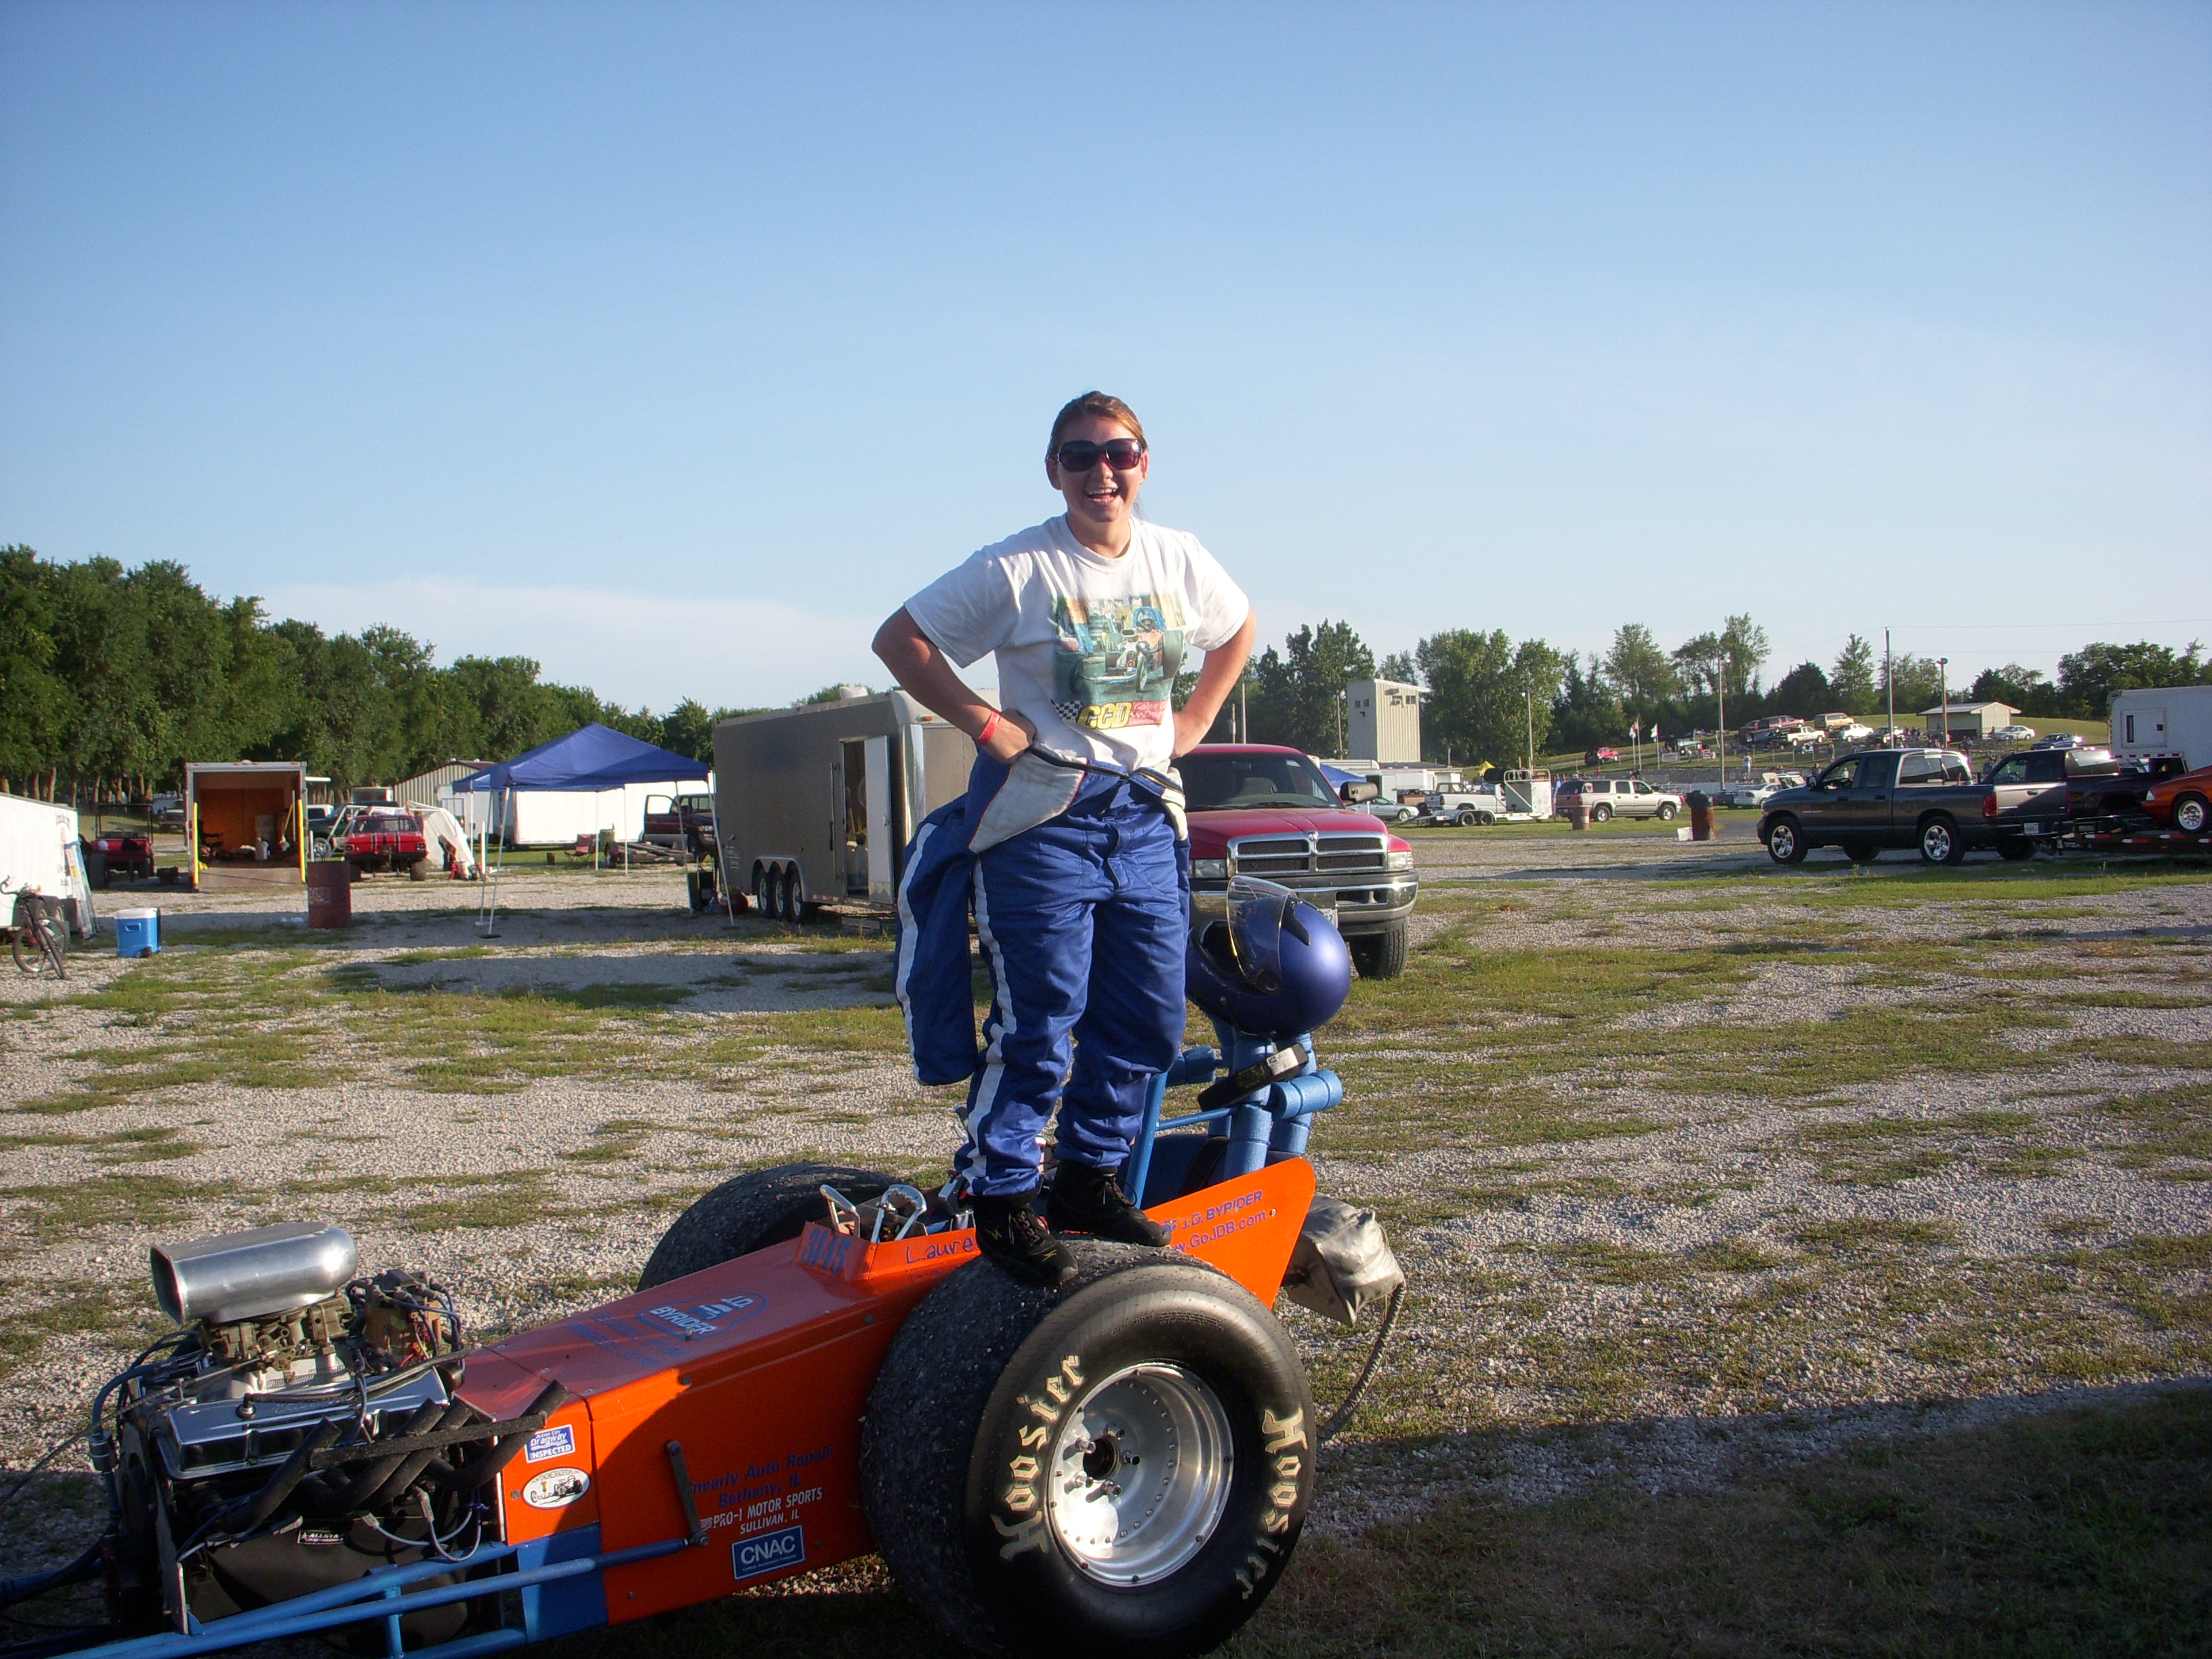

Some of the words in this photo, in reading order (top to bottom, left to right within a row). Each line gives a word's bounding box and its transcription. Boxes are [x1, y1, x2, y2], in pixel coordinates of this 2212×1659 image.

[1206, 1190, 1263, 1221] BYRIDER
[906, 1237, 976, 1263] Laure
[649, 1306, 717, 1334] BYRIDER
[531, 1433, 567, 1446] Dragway
[690, 1470, 740, 1494] nearly
[746, 1463, 782, 1480] Auto
[787, 1446, 834, 1469] Repair
[790, 1473, 802, 1488] IL
[747, 1498, 781, 1519] MOTOR
[785, 1487, 823, 1509] SPORTS
[792, 1510, 800, 1520] IL
[740, 1536, 796, 1565] CNAC
